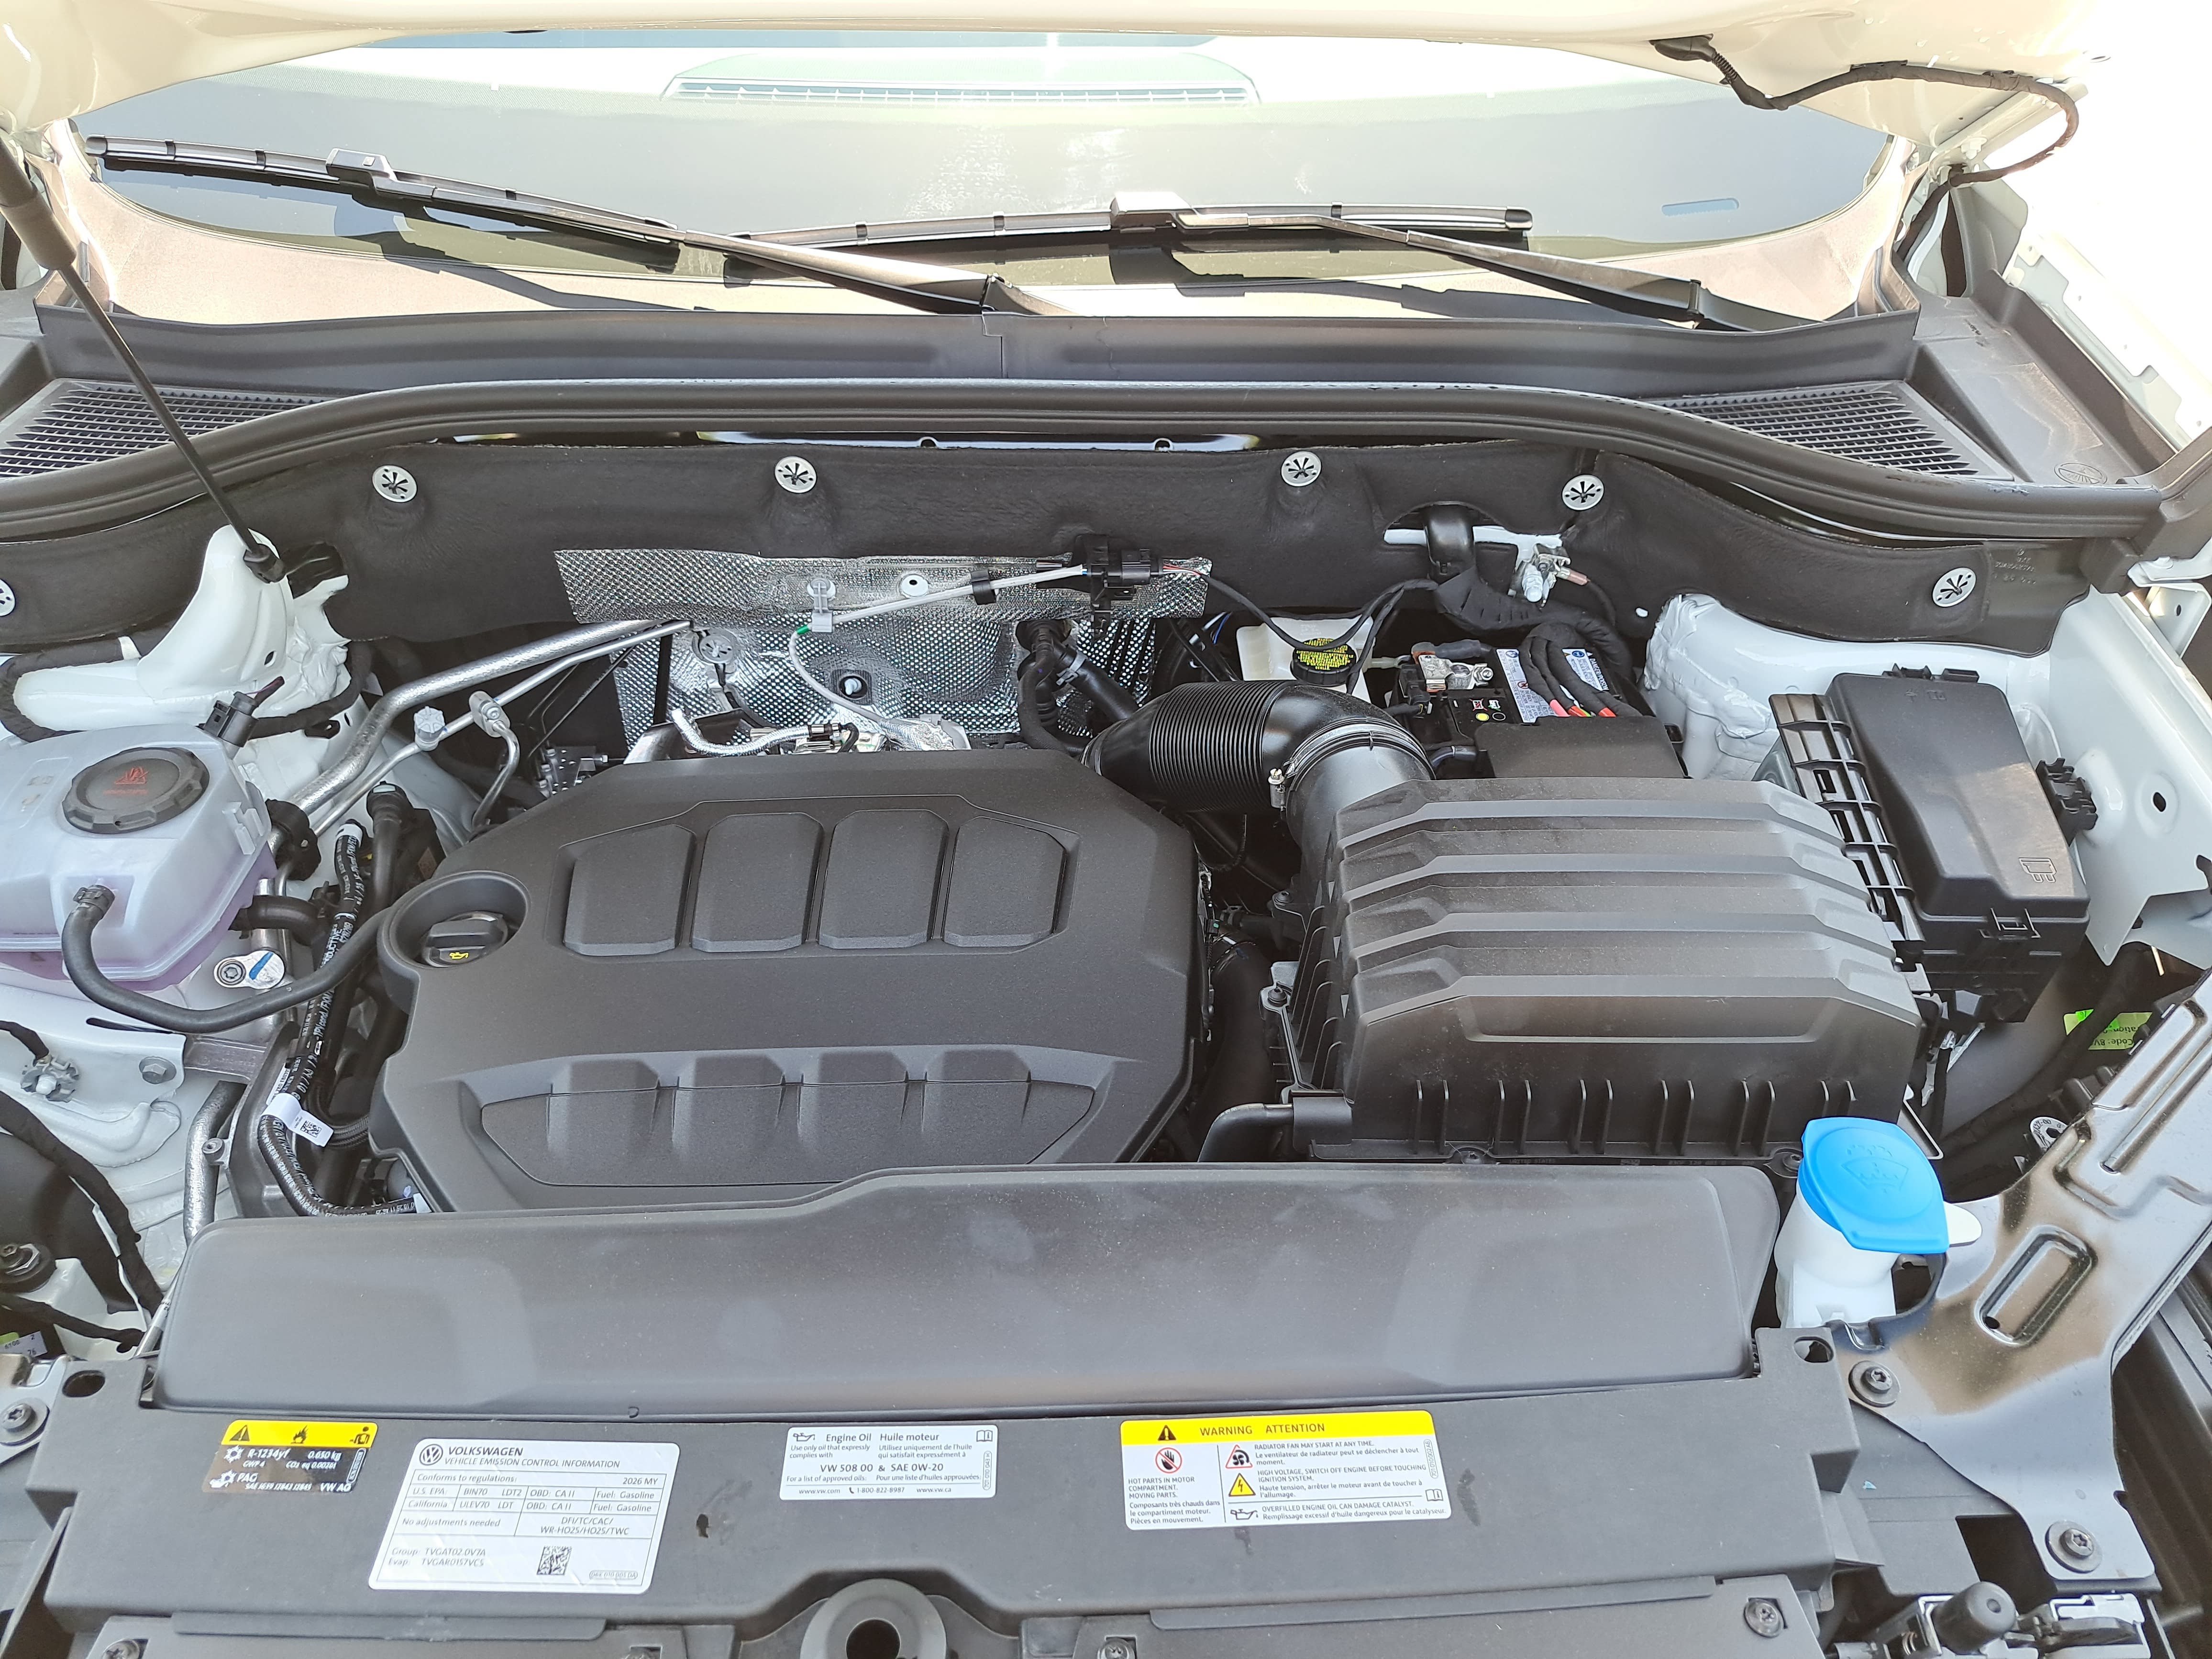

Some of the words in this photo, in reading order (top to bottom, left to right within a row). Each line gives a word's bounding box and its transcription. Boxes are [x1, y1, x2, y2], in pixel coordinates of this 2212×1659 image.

[1200, 1426, 1252, 1436] WARNING
[1266, 1423, 1325, 1434] ATTENTION
[826, 1434, 856, 1443] Engine
[859, 1433, 871, 1441] Oil
[880, 1433, 904, 1441] Huile
[247, 1449, 291, 1461] R-1234yf
[448, 1446, 523, 1456] VOLKSWAGEN
[562, 1460, 620, 1468] INFORMATION
[237, 1472, 258, 1482] PAG
[321, 1482, 337, 1492] VW
[620, 1491, 654, 1499] Gasoline
[408, 1500, 448, 1508] California
[617, 1504, 652, 1512] Gasoline
[1138, 1509, 1184, 1517] compartiment
[416, 1518, 467, 1527] adjustments
